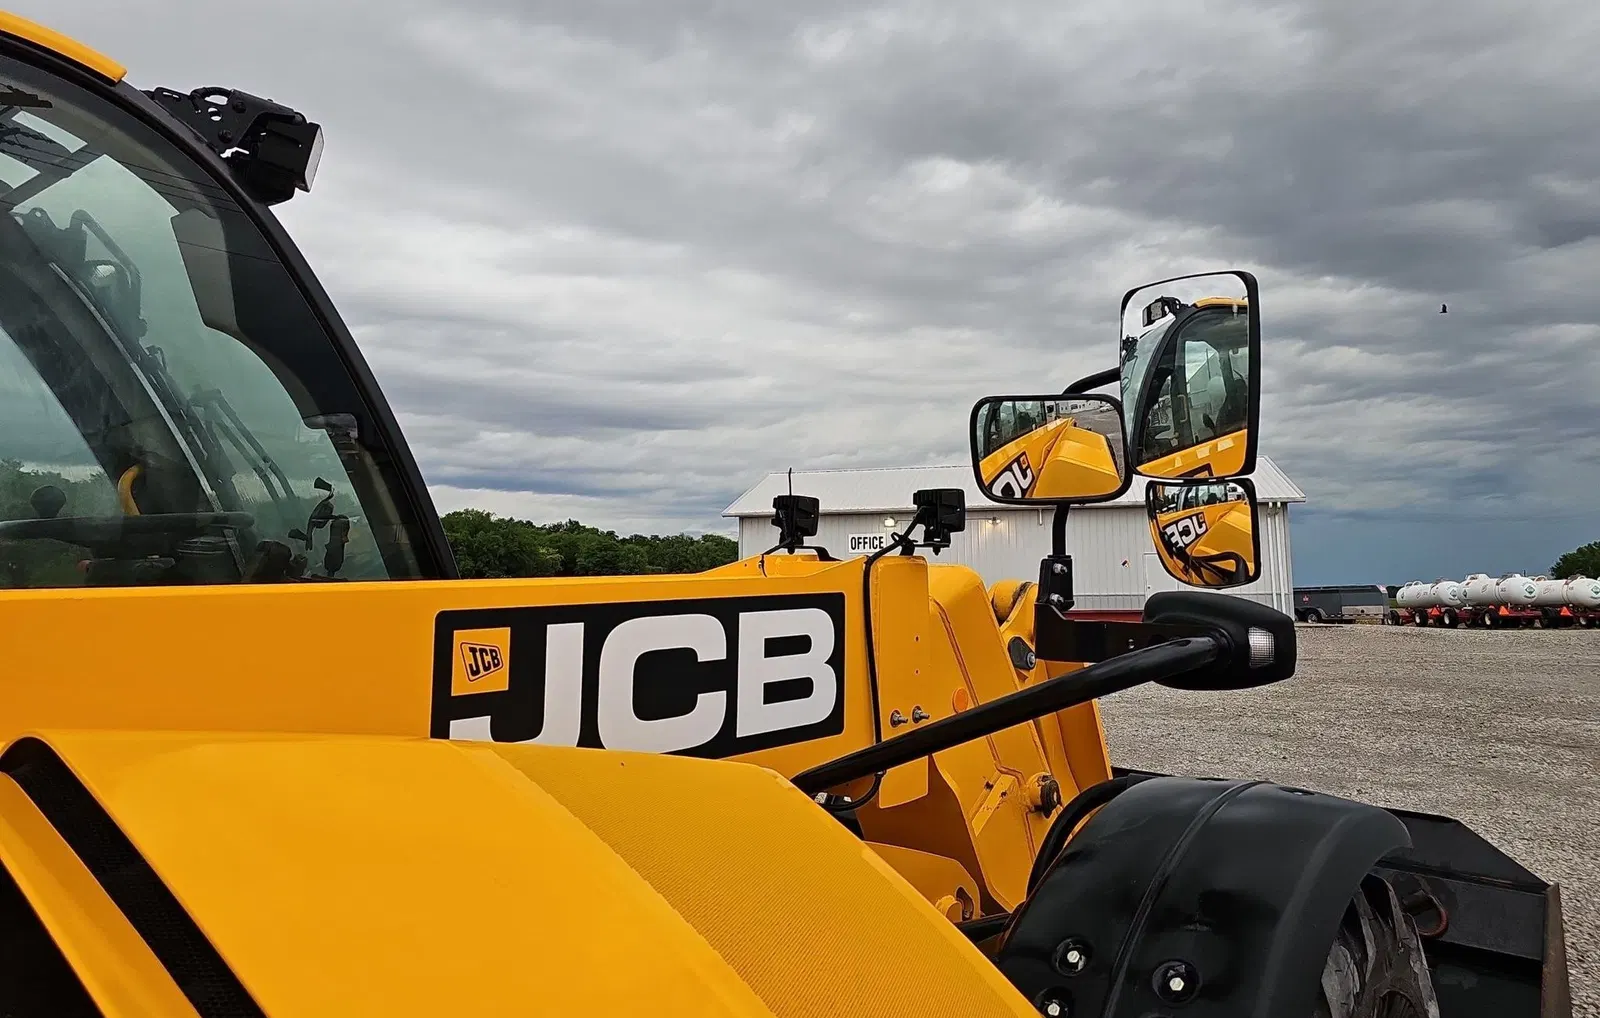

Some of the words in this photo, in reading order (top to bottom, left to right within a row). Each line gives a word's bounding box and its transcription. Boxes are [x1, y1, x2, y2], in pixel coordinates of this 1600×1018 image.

[850, 536, 884, 550] OFFICE
[468, 646, 501, 677] JCB
[449, 607, 837, 754] JCB
